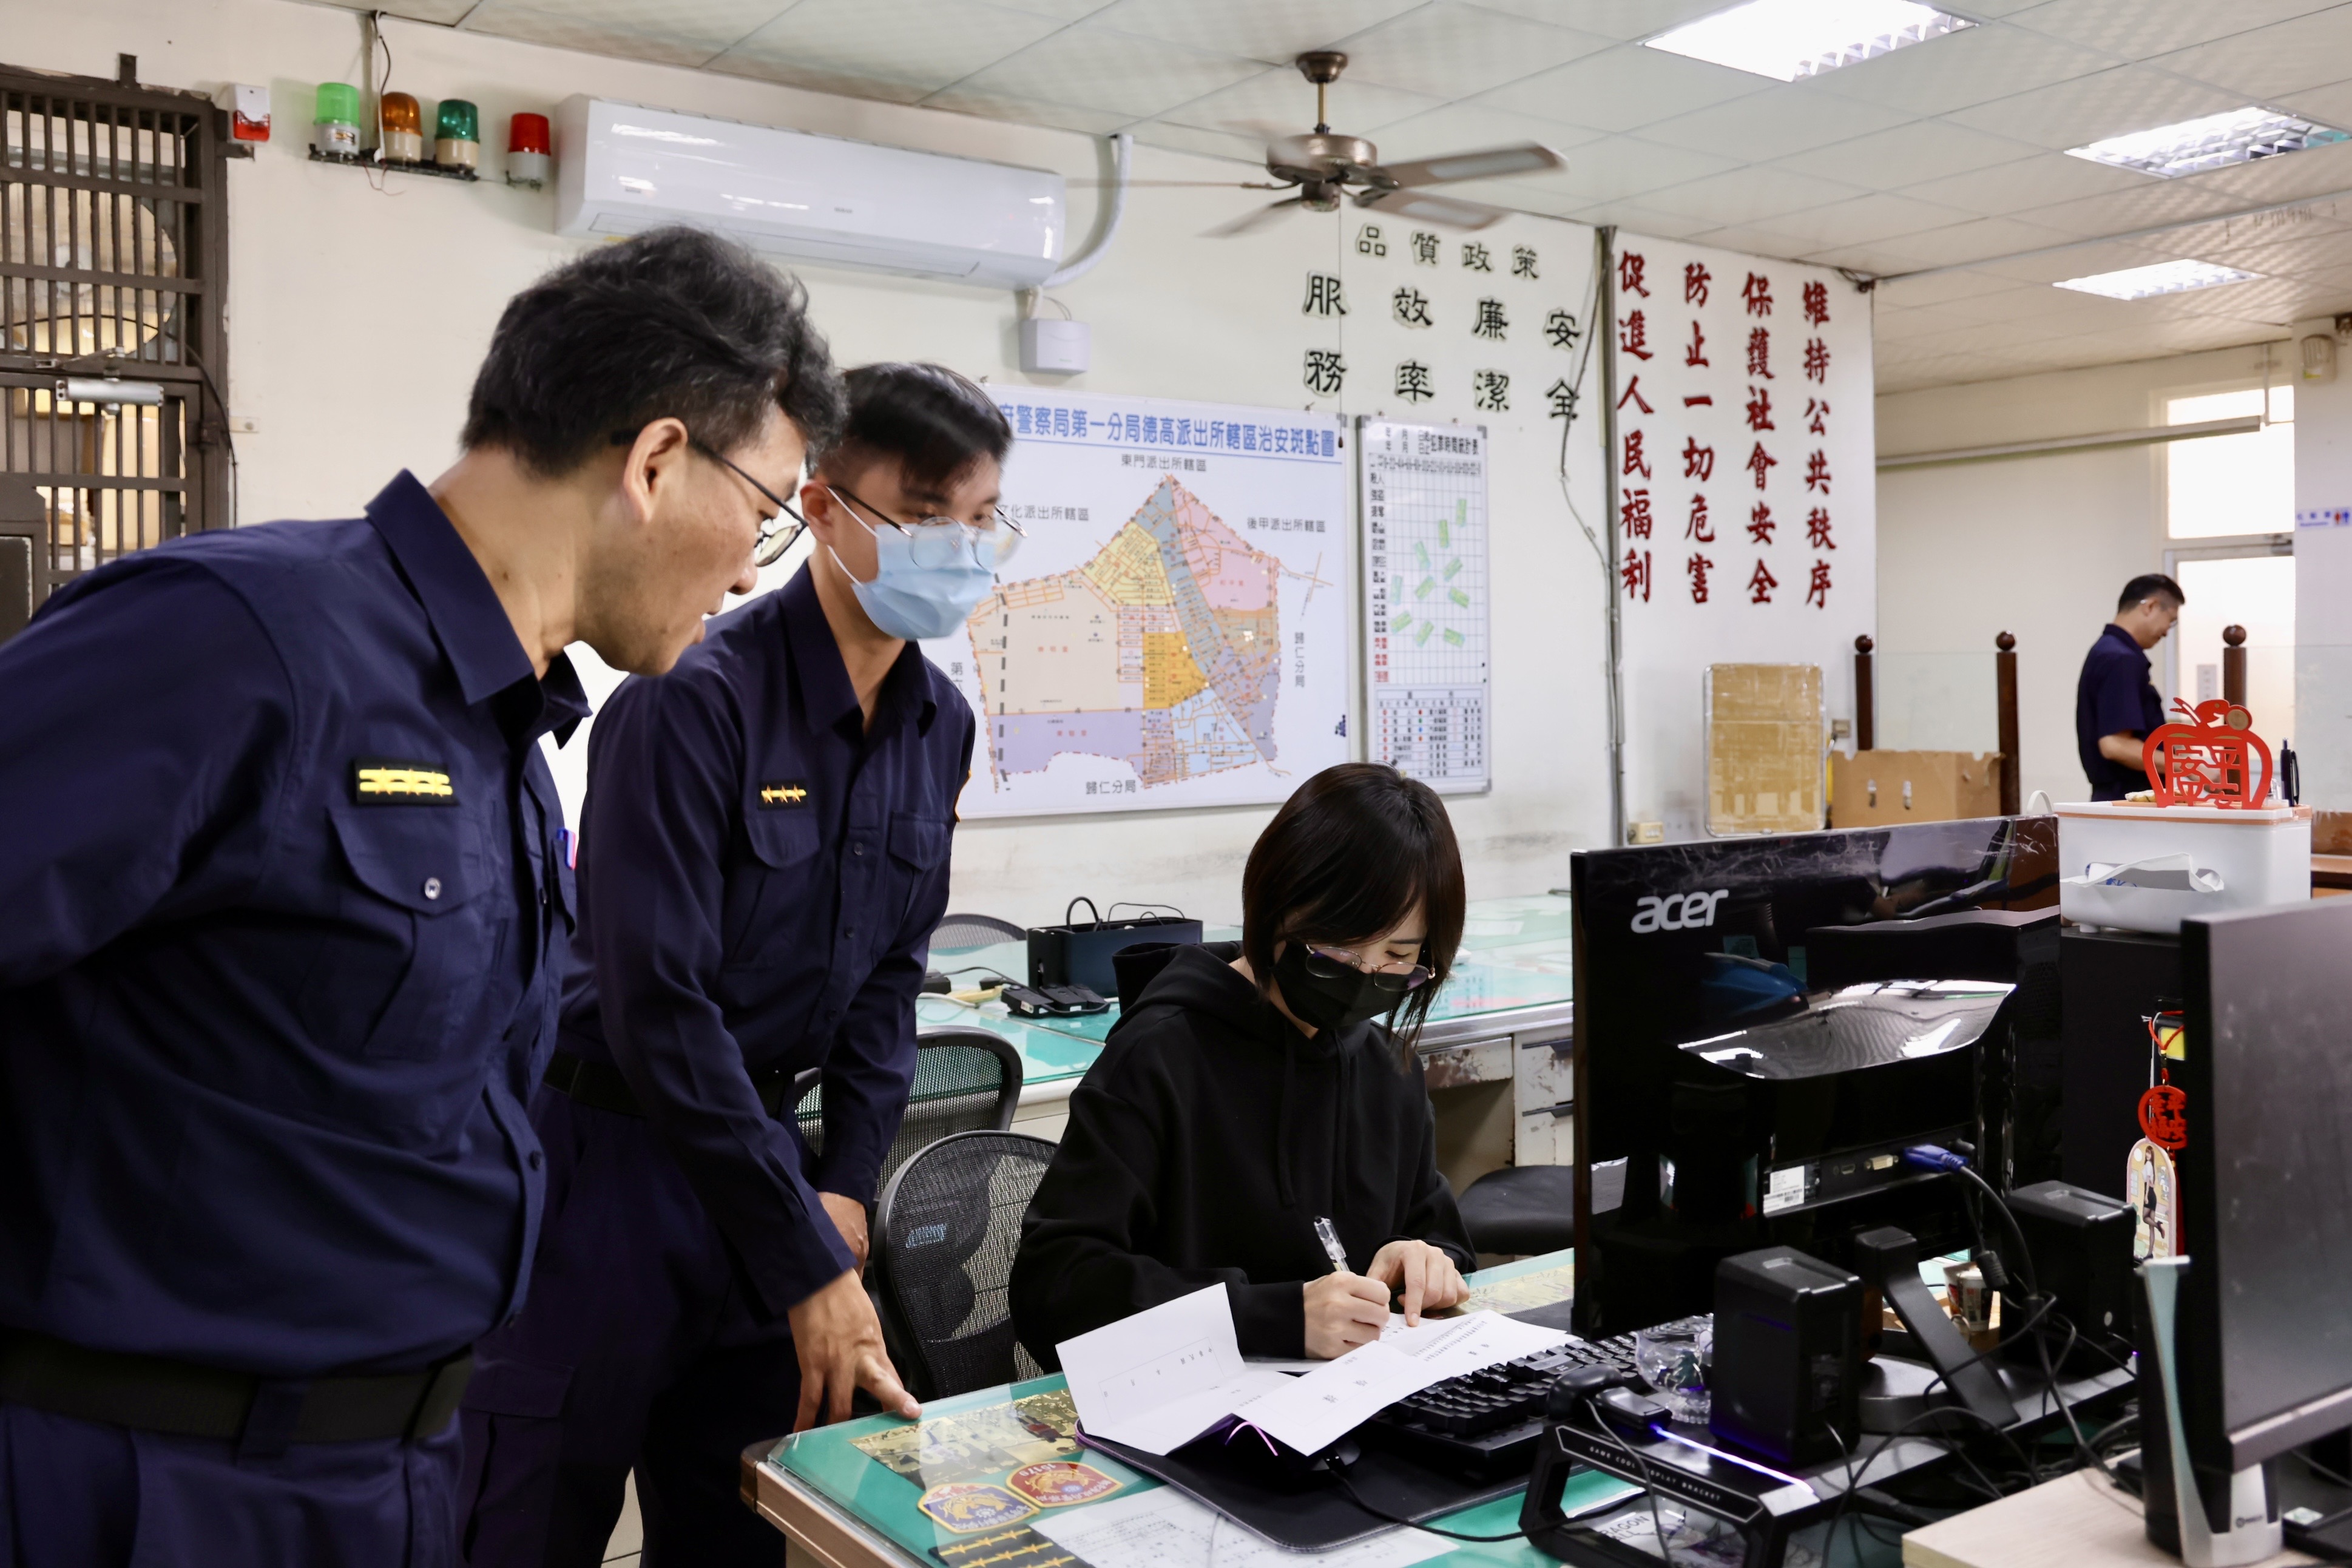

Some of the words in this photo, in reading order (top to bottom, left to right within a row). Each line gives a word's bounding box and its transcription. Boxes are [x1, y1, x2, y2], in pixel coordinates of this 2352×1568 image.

[1357, 226, 1539, 280] 品質政策
[1619, 250, 1654, 604] 促進人民福利
[1684, 263, 1715, 604] 防止一切危害
[1741, 273, 1777, 606] 保護社會安全
[1802, 280, 1836, 609] 維持公共秩序
[1121, 453, 1206, 472] 東門派出所轄區
[1247, 516, 1326, 533] 後甲派出所轄區
[1085, 779, 1137, 796] 歸仁分局
[1631, 888, 1729, 934] acer
[1681, 1481, 1722, 1502] BRACKET
